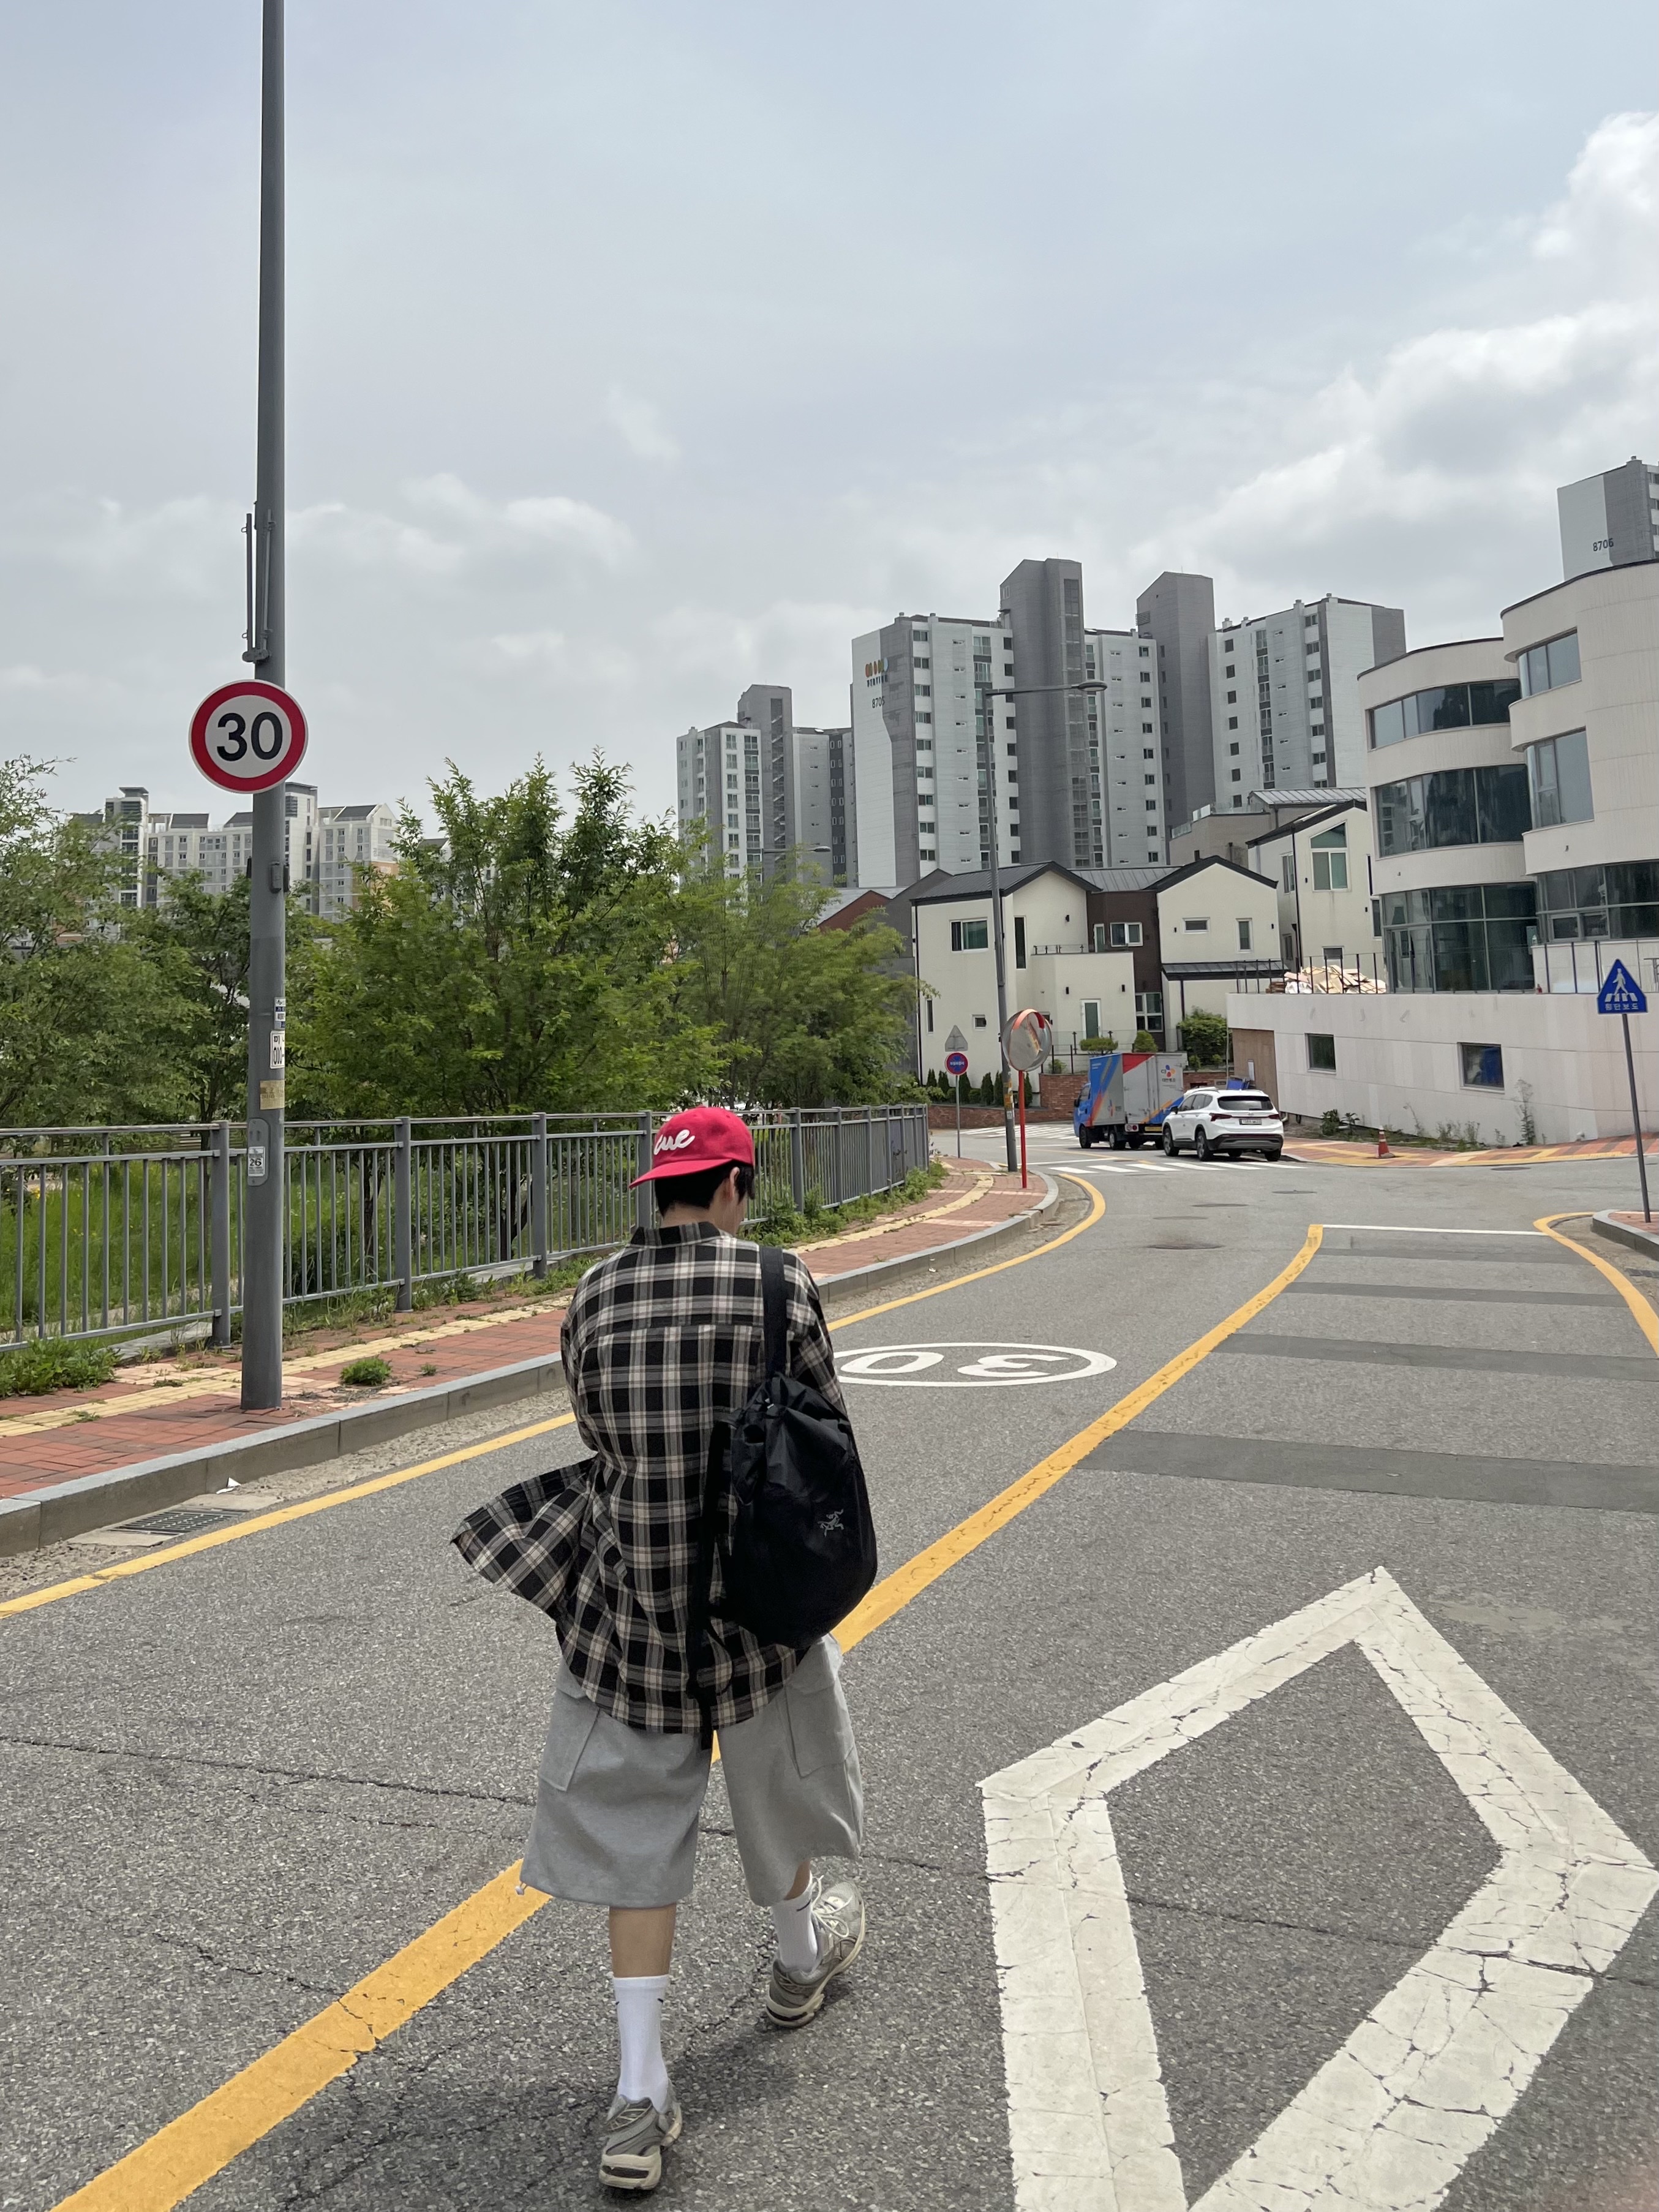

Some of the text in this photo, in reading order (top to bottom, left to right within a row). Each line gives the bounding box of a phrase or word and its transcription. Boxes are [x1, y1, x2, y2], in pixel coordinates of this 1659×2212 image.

[1593, 538, 1614, 552] 8706
[872, 696, 886, 709] 8705
[217, 712, 283, 761] 30
[840, 1351, 1069, 1378] 30
